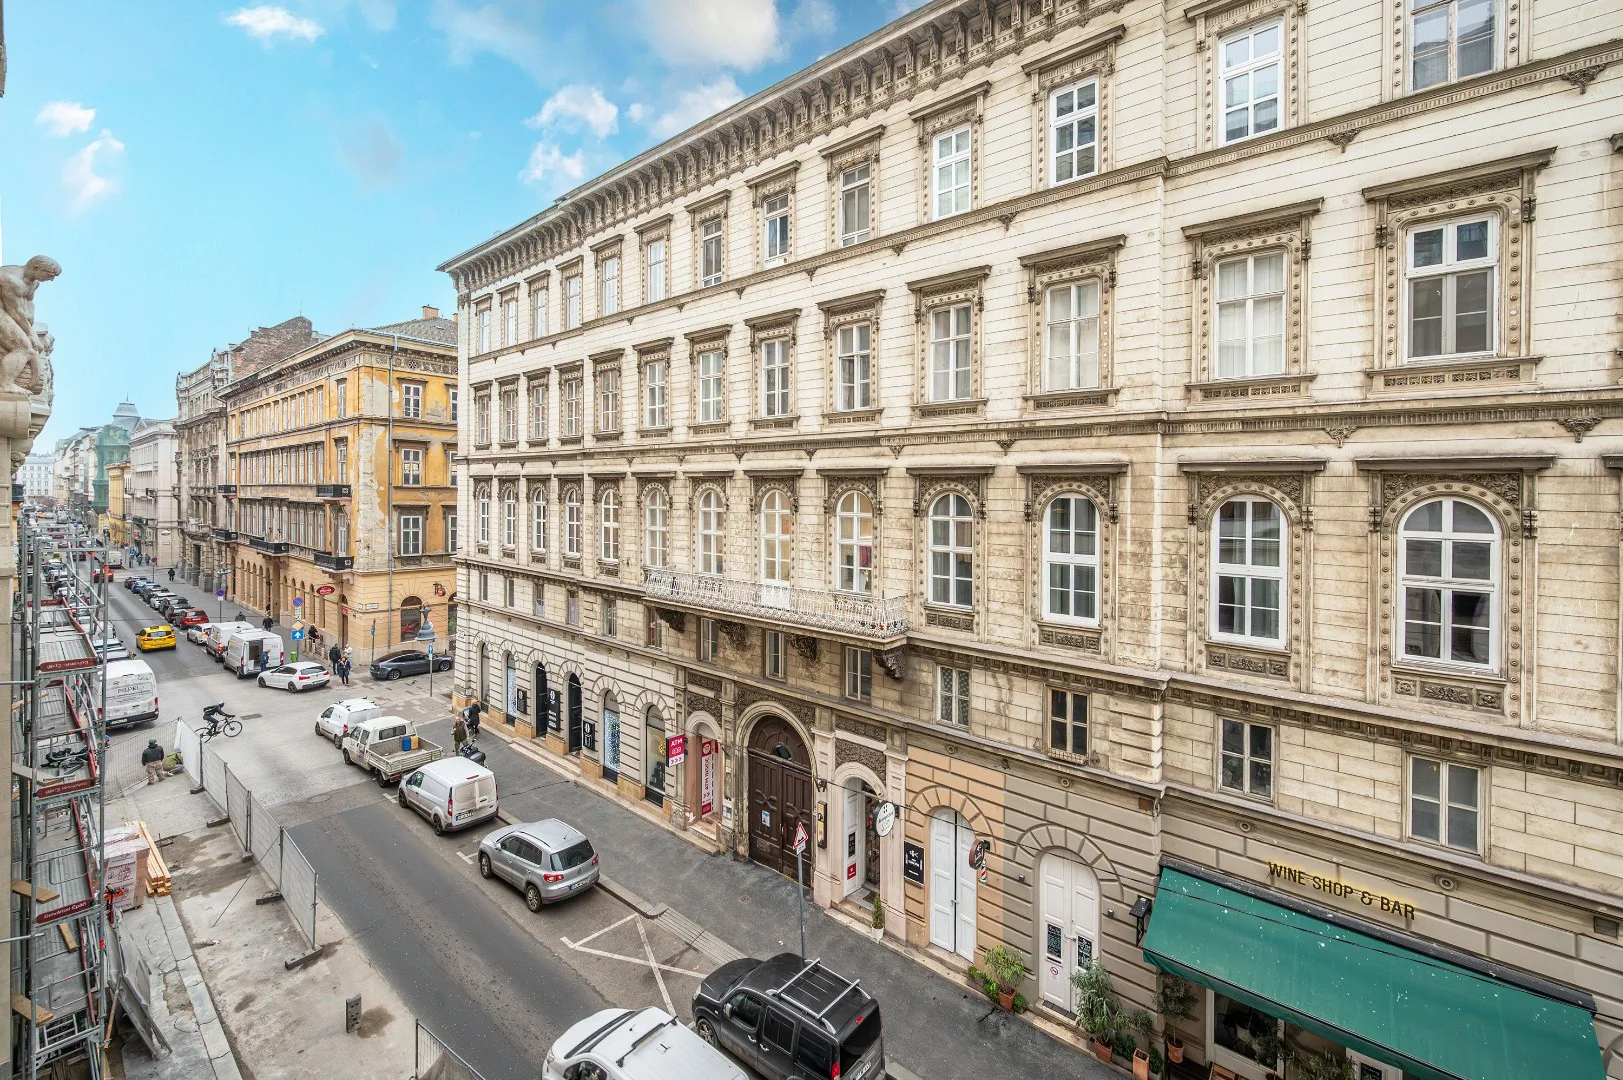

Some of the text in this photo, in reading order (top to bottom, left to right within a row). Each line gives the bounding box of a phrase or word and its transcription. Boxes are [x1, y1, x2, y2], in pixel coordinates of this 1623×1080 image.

[671, 738, 683, 747] ATM
[1268, 862, 1415, 920] WINE SHOP & BAR
